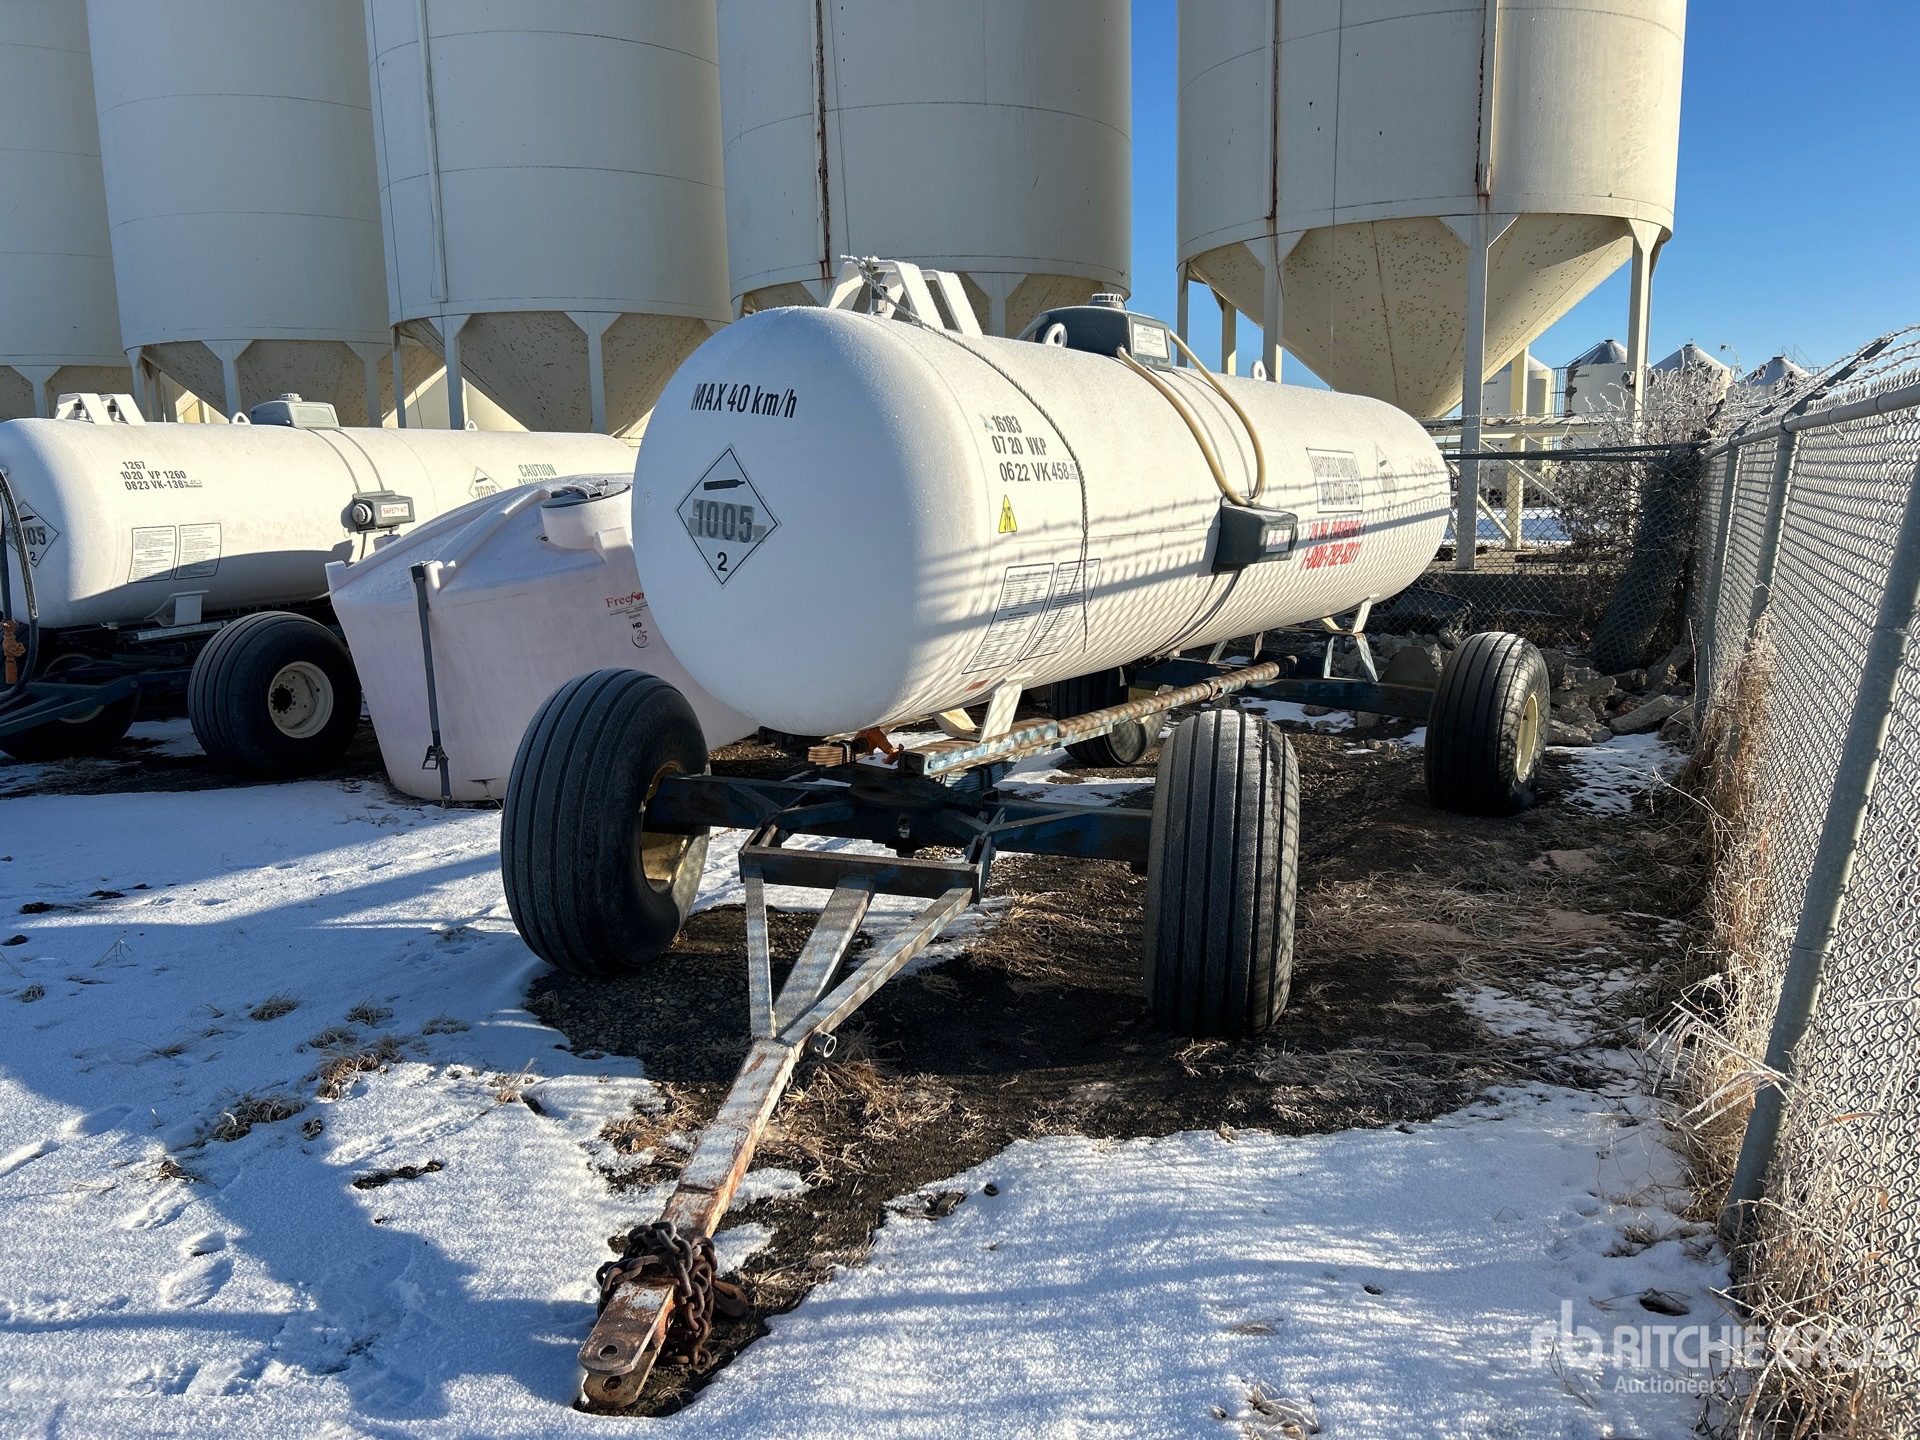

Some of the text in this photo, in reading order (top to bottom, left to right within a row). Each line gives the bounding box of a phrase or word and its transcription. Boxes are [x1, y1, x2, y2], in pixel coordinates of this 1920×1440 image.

[691, 383, 798, 419] MAX 40 km/h
[1025, 436, 1046, 455] VKP
[122, 460, 146, 470] 1267
[518, 464, 557, 478] CAUTION
[147, 470, 161, 480] VP
[163, 470, 187, 479] 1260
[124, 481, 150, 490] 0823
[695, 500, 753, 544] 1005
[30, 551, 37, 561] 2
[717, 551, 728, 572] 2
